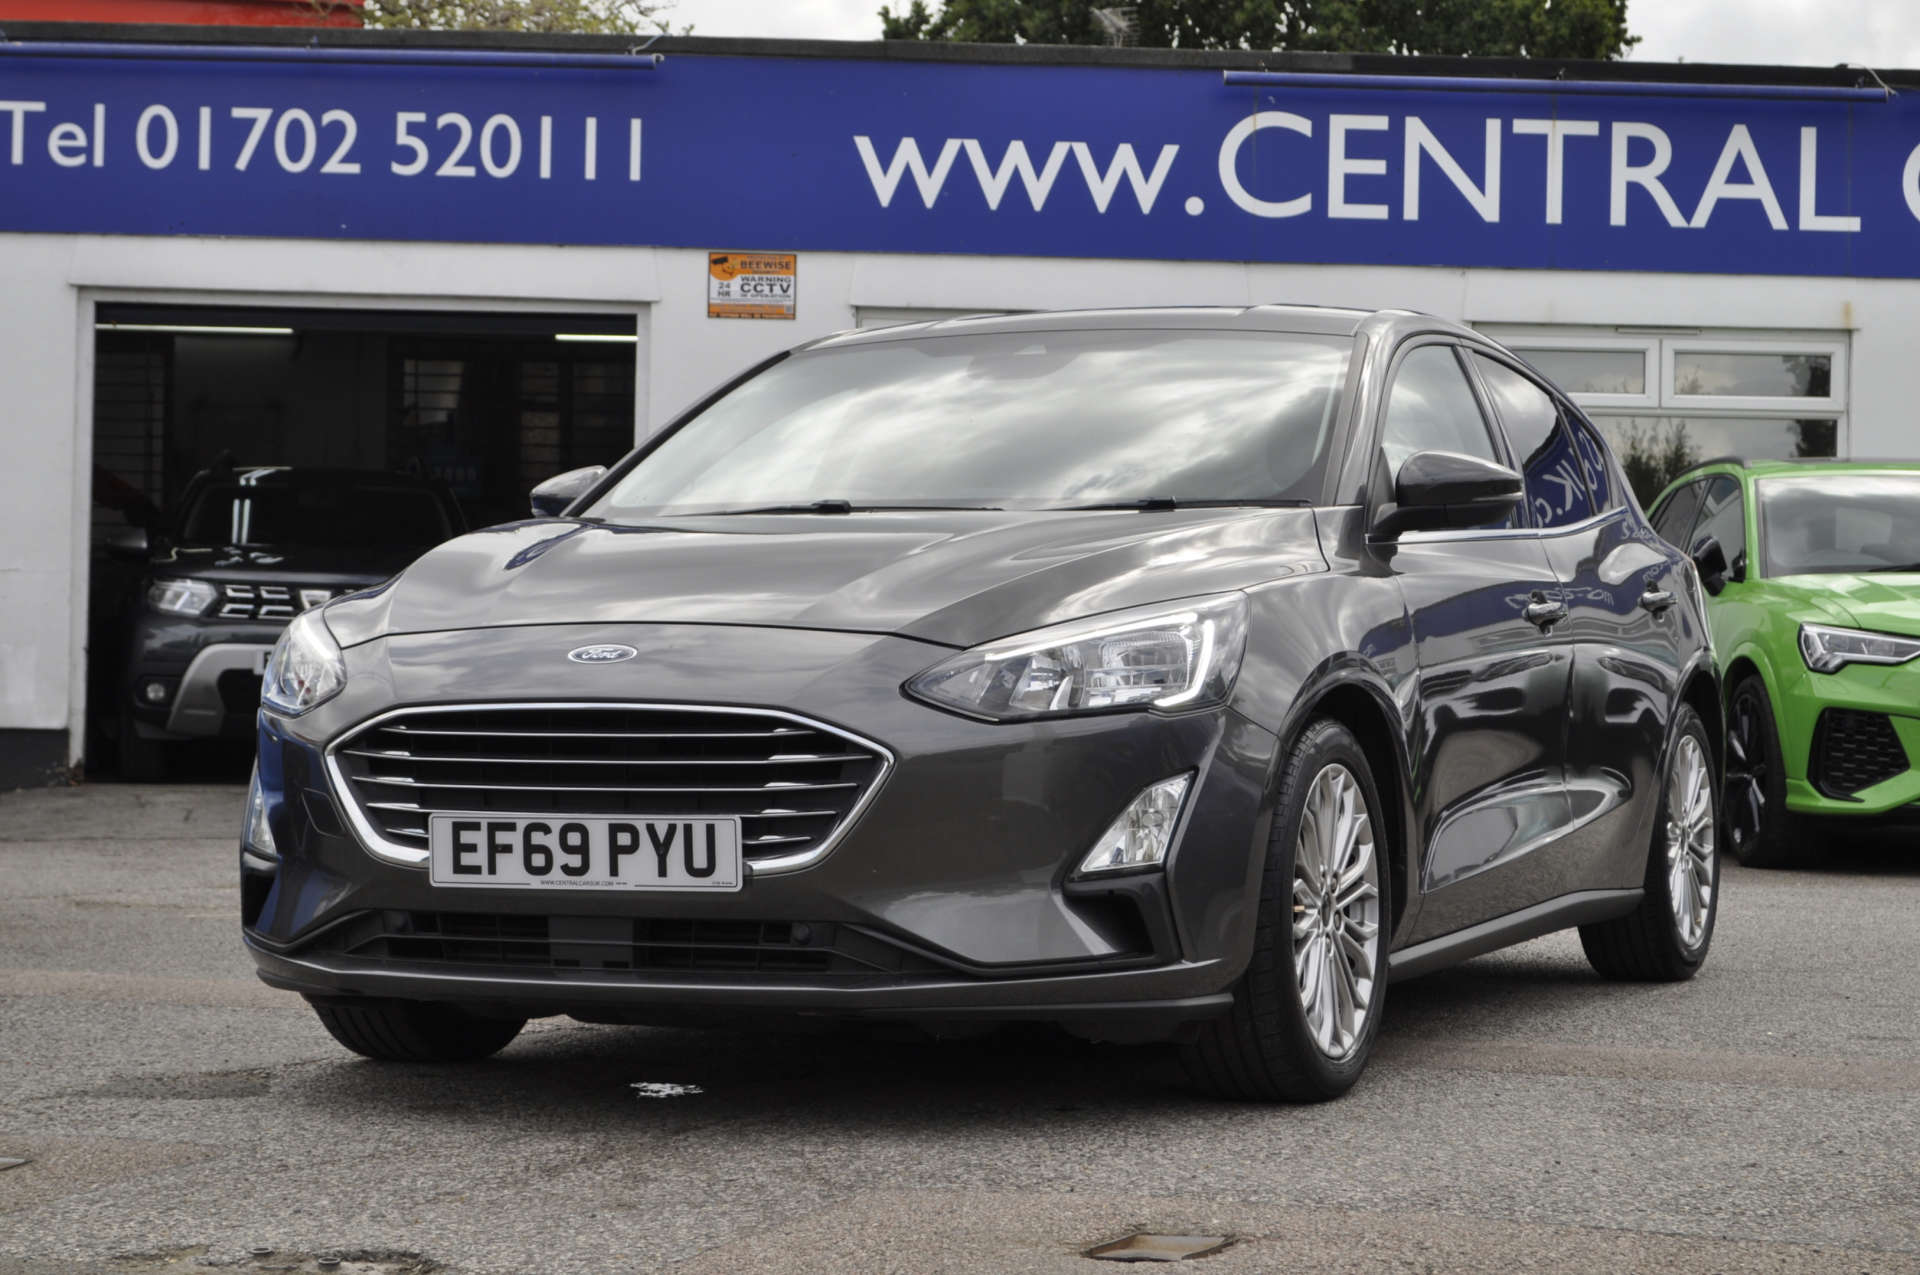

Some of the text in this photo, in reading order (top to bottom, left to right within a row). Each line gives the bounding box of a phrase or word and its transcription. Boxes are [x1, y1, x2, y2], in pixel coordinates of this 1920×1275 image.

[0, 101, 641, 181] Tel 01702 520111
[740, 260, 792, 270] BEEWISE
[740, 283, 791, 294] CCTV
[581, 647, 623, 659] Ford
[452, 821, 717, 878] EF69 PYU
